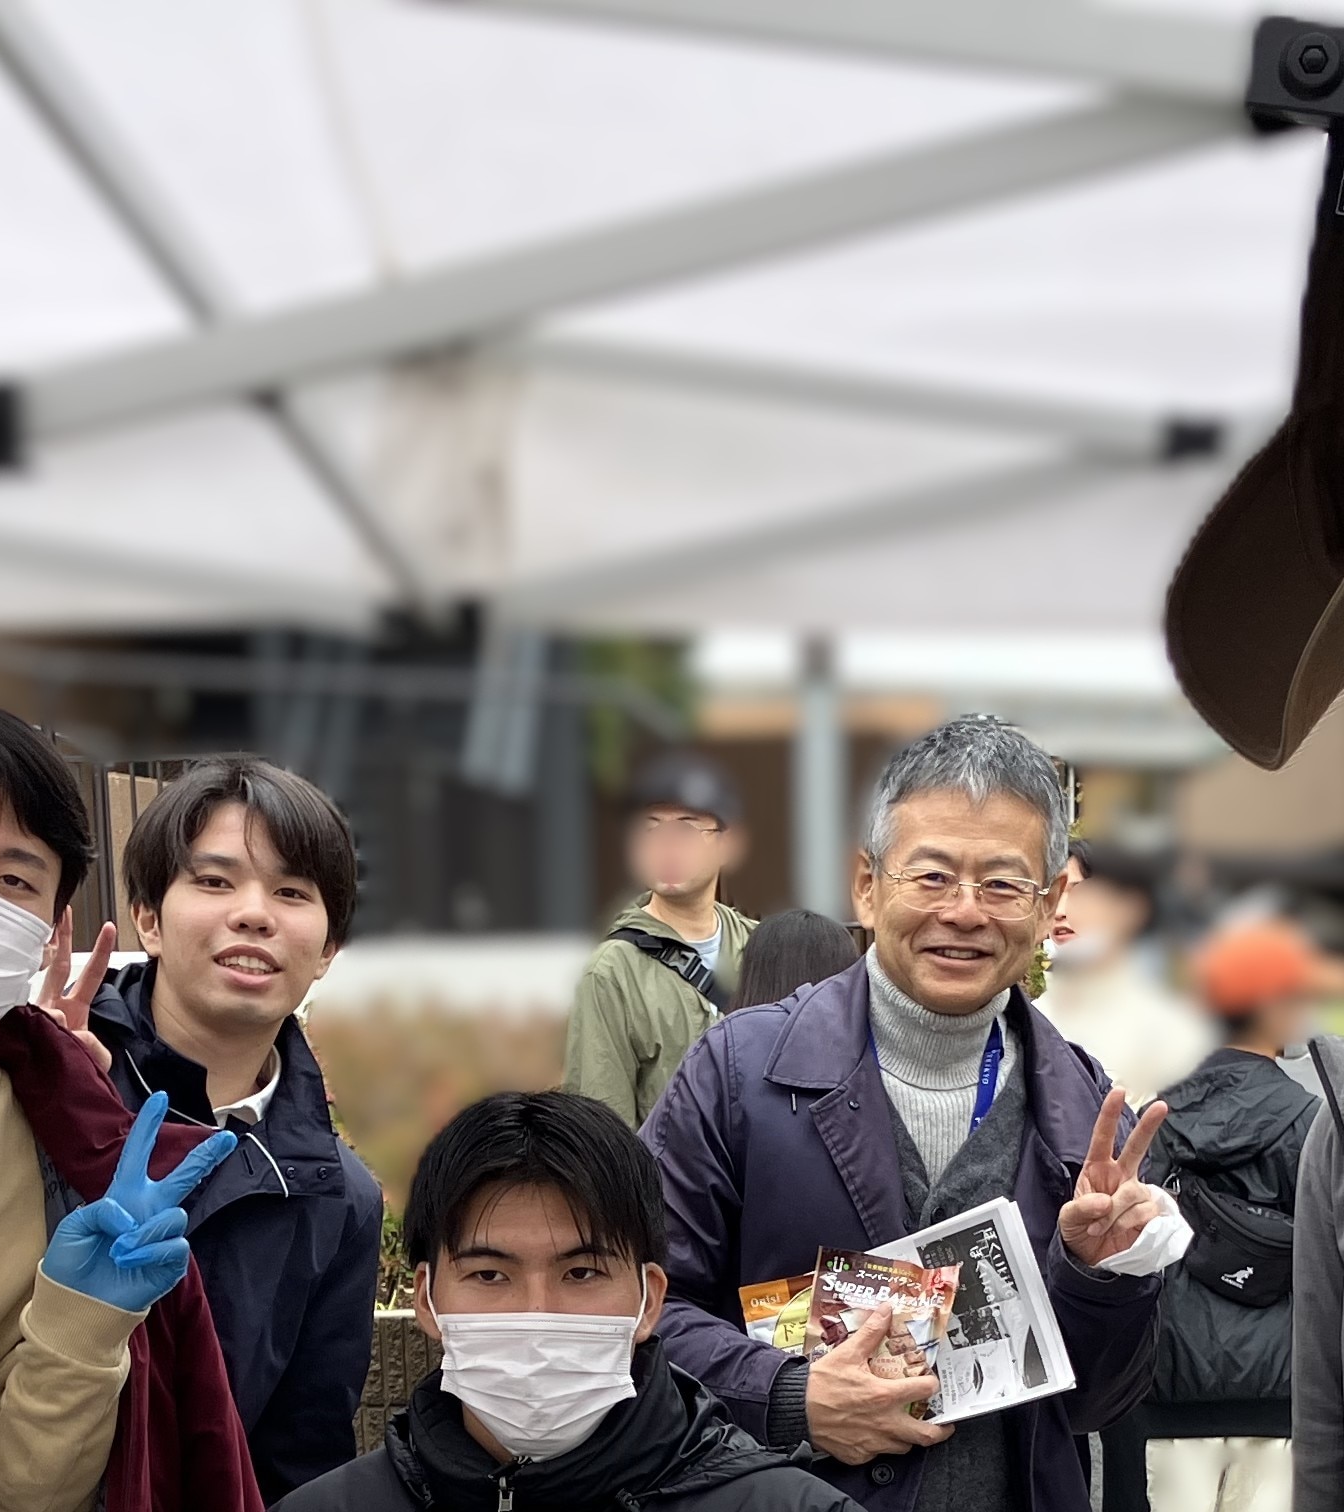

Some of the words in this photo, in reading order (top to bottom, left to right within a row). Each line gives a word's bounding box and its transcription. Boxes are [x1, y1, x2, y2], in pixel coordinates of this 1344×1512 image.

[820, 1272, 875, 1299] SUPER
[856, 1269, 922, 1291] スーパーバランス
